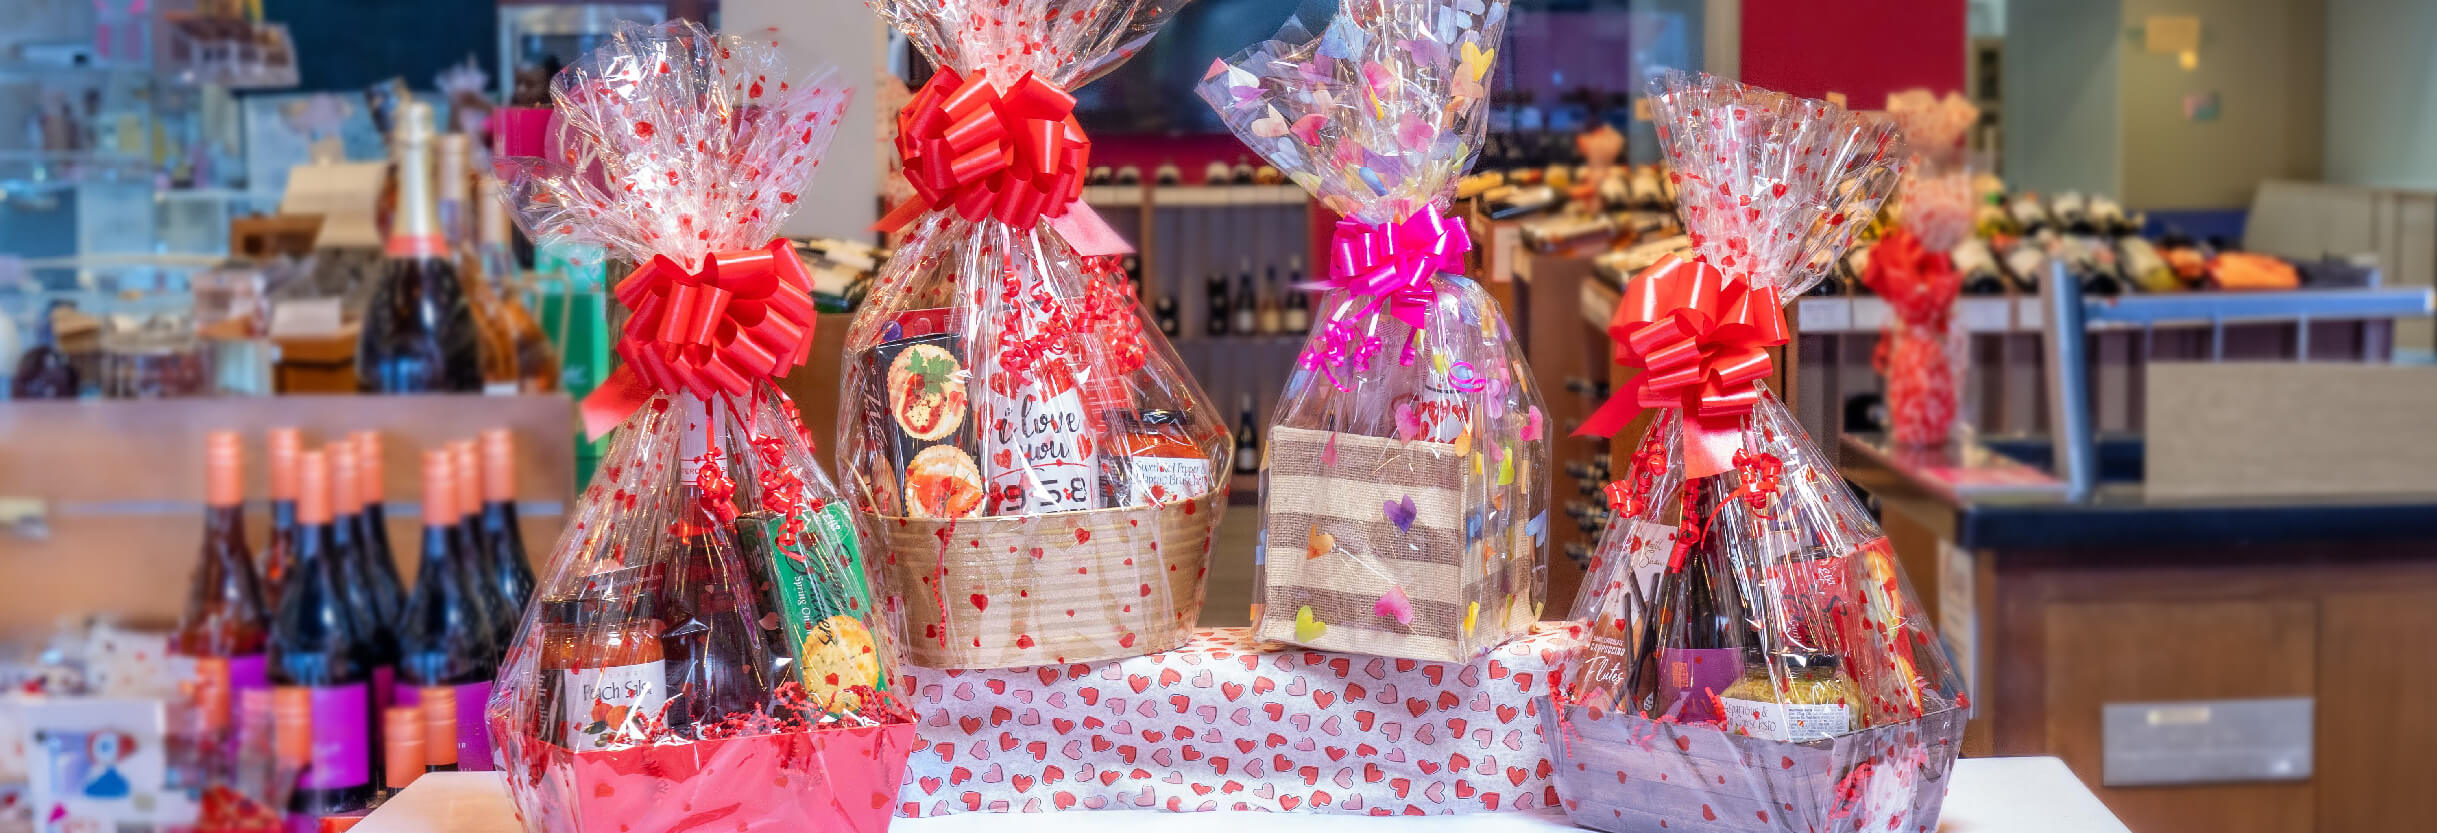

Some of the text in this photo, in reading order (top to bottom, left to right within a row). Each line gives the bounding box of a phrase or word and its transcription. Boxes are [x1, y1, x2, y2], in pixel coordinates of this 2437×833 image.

[1021, 394, 1081, 438] love
[1019, 441, 1070, 467] you
[794, 575, 813, 634] Spring Onin
[1583, 655, 1625, 686] Flutes
[583, 682, 620, 701] Peach
